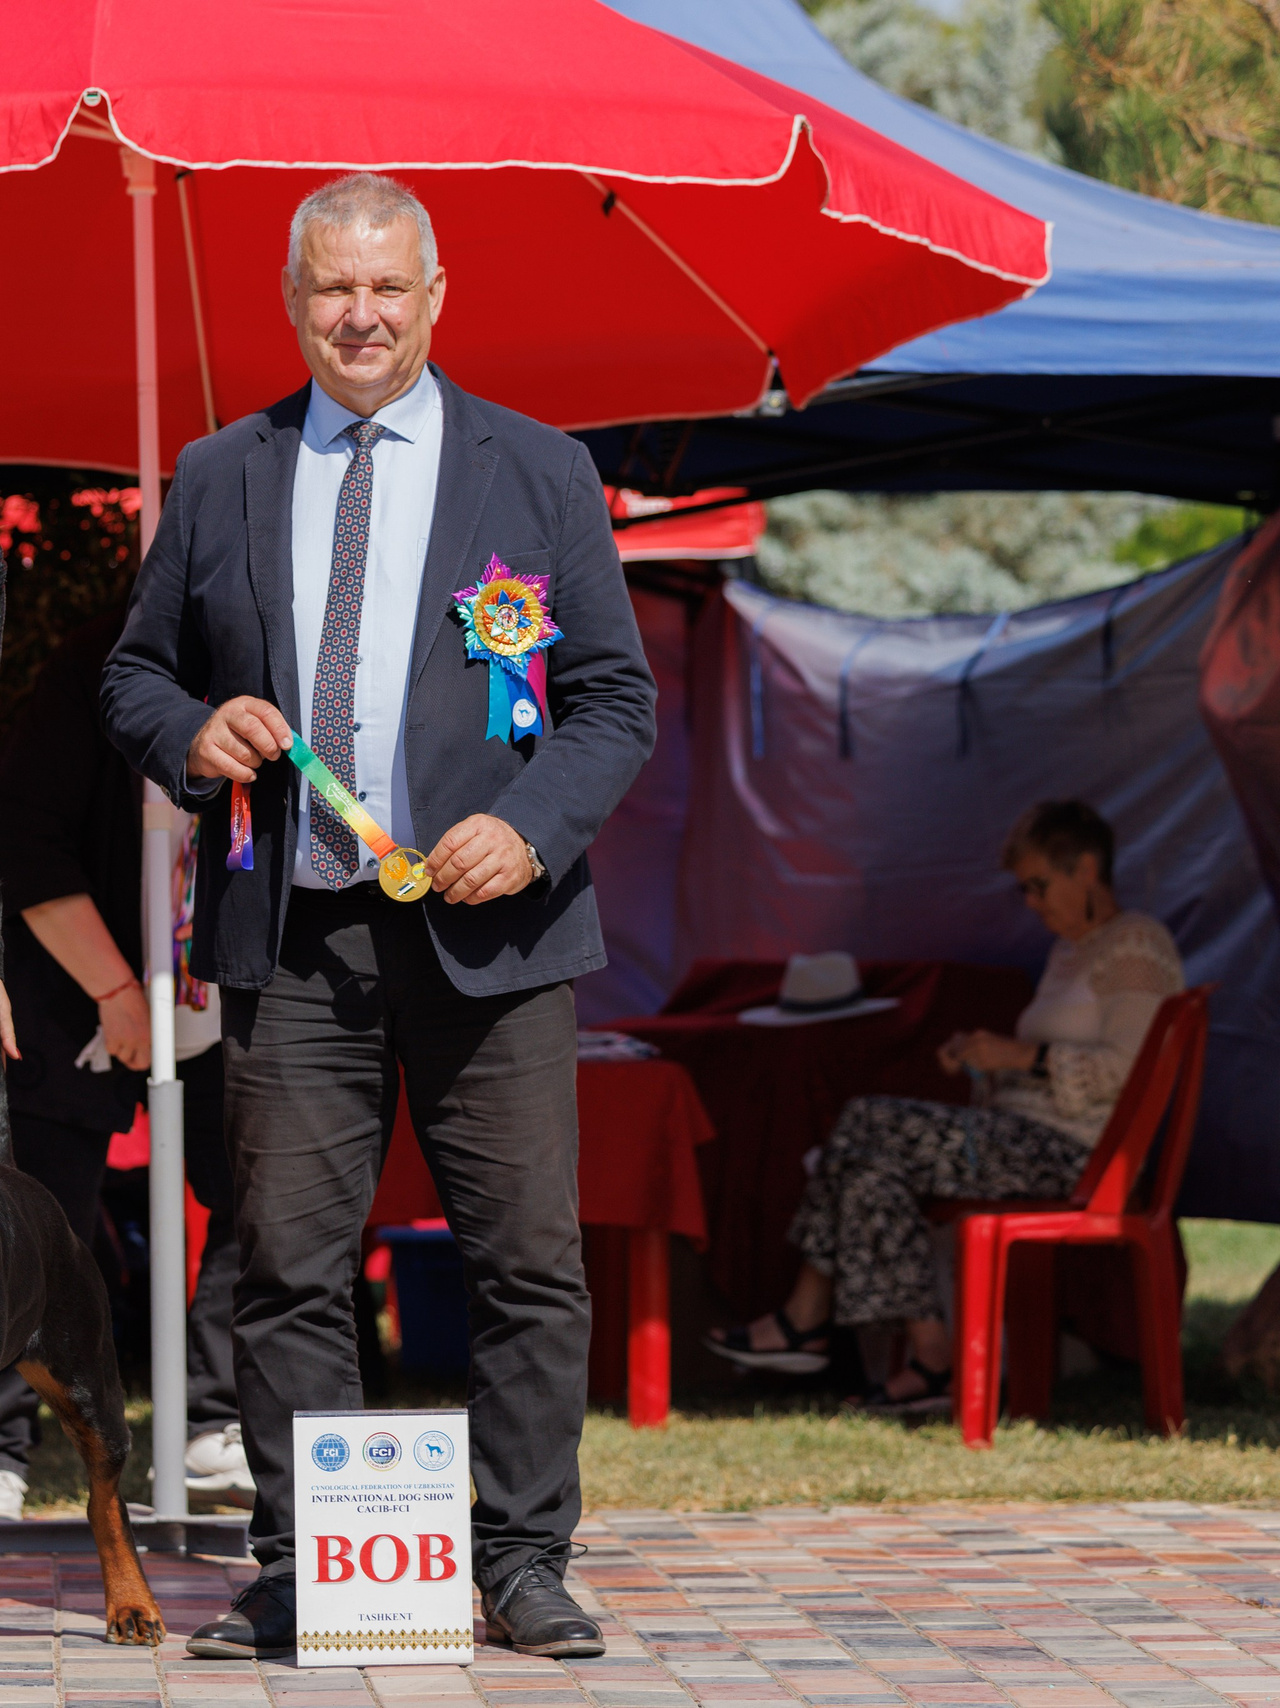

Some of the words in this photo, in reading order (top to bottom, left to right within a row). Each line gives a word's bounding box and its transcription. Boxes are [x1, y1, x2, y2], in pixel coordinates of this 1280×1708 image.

[323, 1448, 339, 1457] FCI
[372, 1448, 392, 1456] FCI
[312, 1494, 396, 1503] INTERNATIONAL
[398, 1494, 421, 1502] DOG
[423, 1493, 455, 1501] SHOW
[357, 1504, 410, 1513] CACIB-FCI
[311, 1533, 457, 1584] BOB
[358, 1612, 413, 1622] TASHKENT
